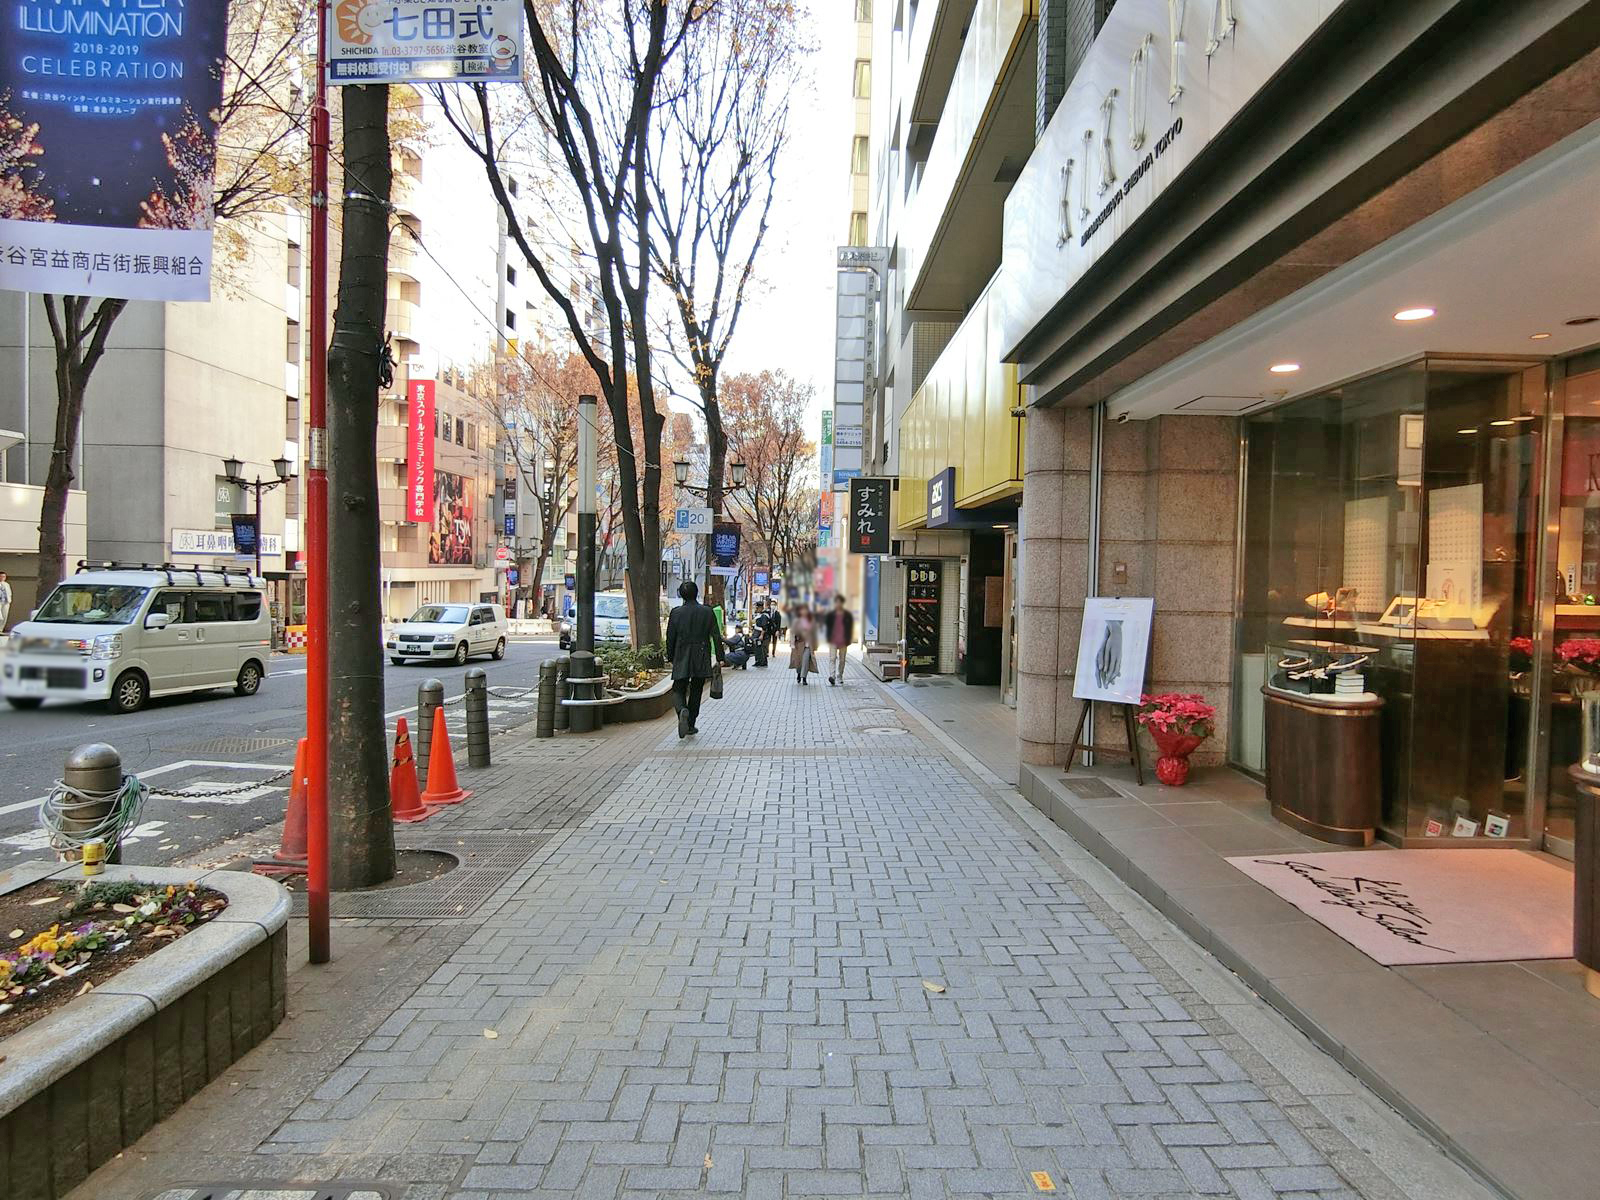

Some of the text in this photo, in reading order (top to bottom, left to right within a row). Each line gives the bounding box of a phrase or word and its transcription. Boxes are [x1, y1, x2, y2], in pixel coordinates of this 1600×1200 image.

[20, 6, 183, 37] ILLUMINATION
[384, 5, 493, 40] 七田式
[73, 43, 139, 55] 2018-2019
[341, 47, 379, 56] SHICHIDA
[446, 44, 489, 55] 渋谷教室
[22, 56, 183, 79] CELEBRATION
[337, 61, 409, 76] 無料体験受付中
[466, 61, 487, 72] 検索
[1123, 152, 1153, 195] SHIBUYA
[1154, 117, 1183, 159] TOKYO
[680, 511, 705, 525] P 20
[857, 486, 876, 534] すみれ
